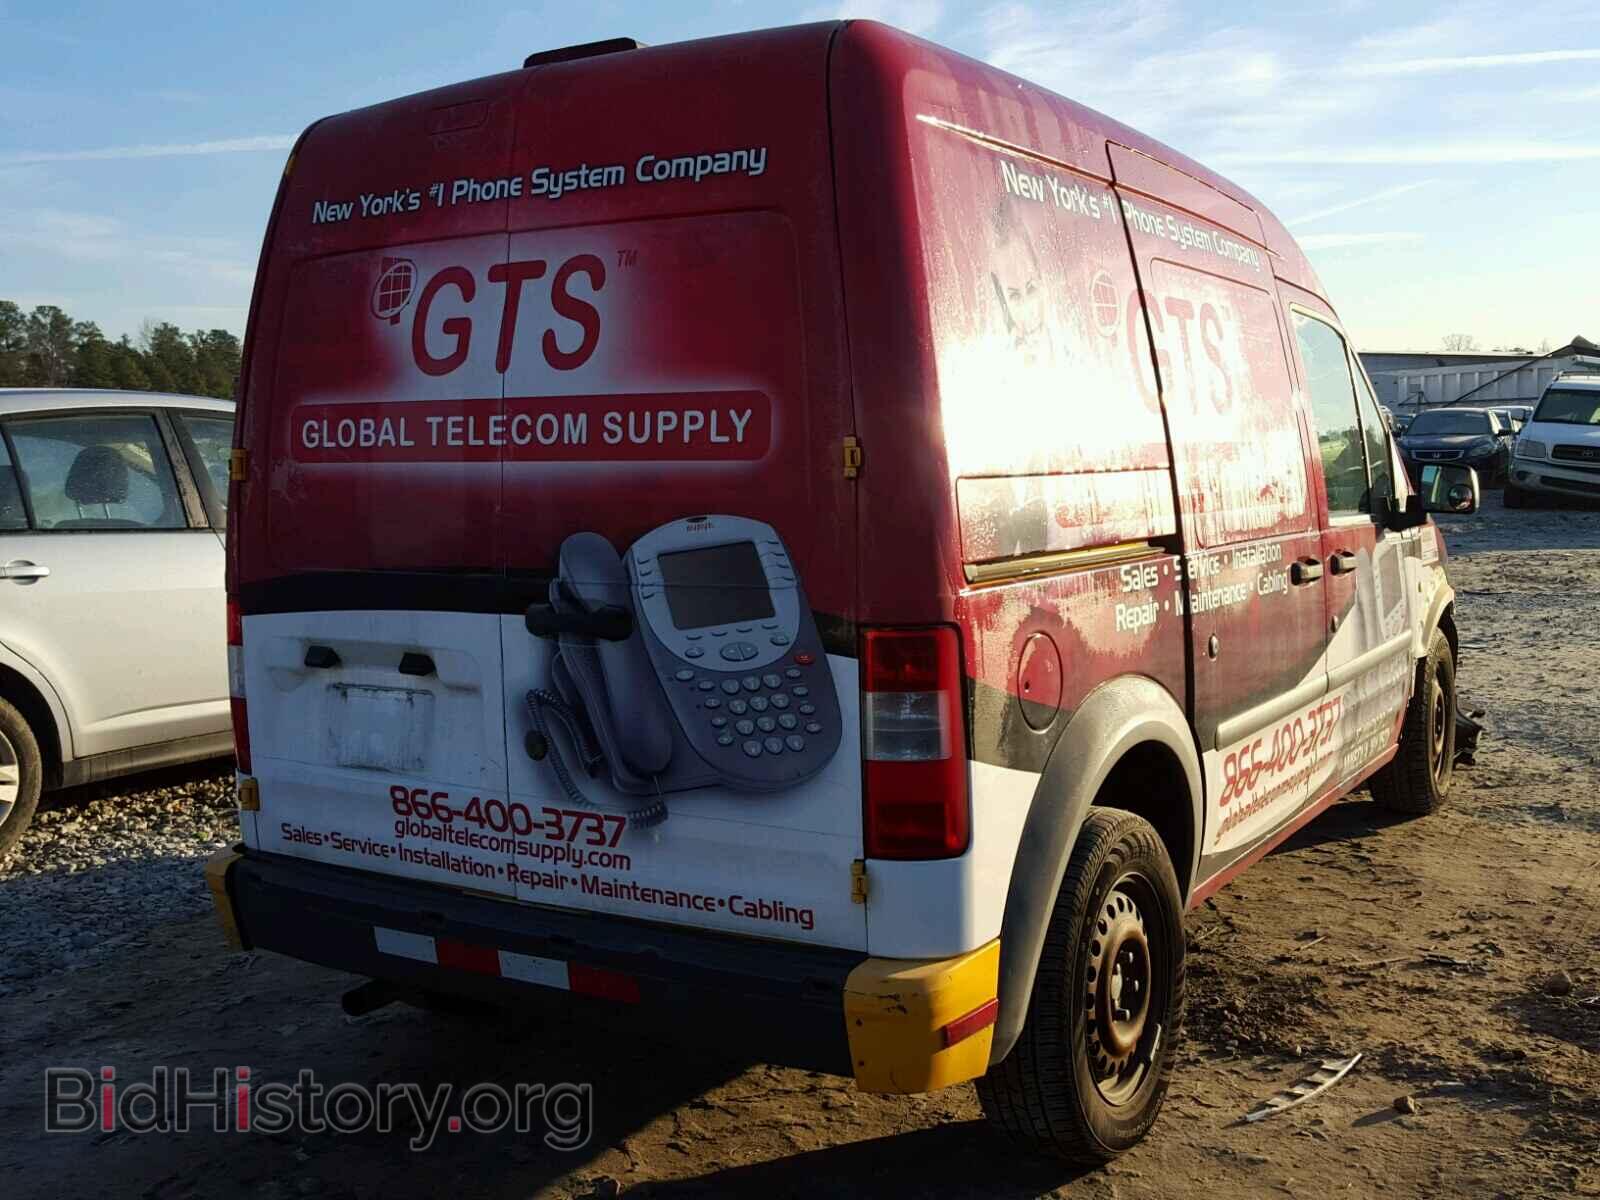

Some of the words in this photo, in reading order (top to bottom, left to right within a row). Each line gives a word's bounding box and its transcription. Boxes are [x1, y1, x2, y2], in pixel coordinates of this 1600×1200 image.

[311, 200, 354, 224] New
[360, 188, 421, 217] York's
[428, 182, 445, 207] #1
[451, 176, 523, 205] Phone
[530, 163, 626, 199] System
[635, 147, 767, 184] Company
[1002, 160, 1044, 202] New
[1045, 174, 1101, 219] York's
[1166, 214, 1214, 253] System
[1213, 230, 1260, 273] Company
[617, 249, 638, 267] TM
[411, 254, 607, 377] GTS
[1125, 288, 1235, 417] GTS
[301, 417, 415, 449] GLOBAL
[426, 413, 588, 447] TELECOM
[602, 409, 753, 444] SUPPLY
[1120, 563, 1158, 592] Sales
[1231, 542, 1282, 571] Installation
[1115, 597, 1160, 633] Repair
[1256, 569, 1289, 596] Cabling
[389, 784, 627, 849] 866-400-3737
[394, 815, 631, 871] globaltelecomsupply.com
